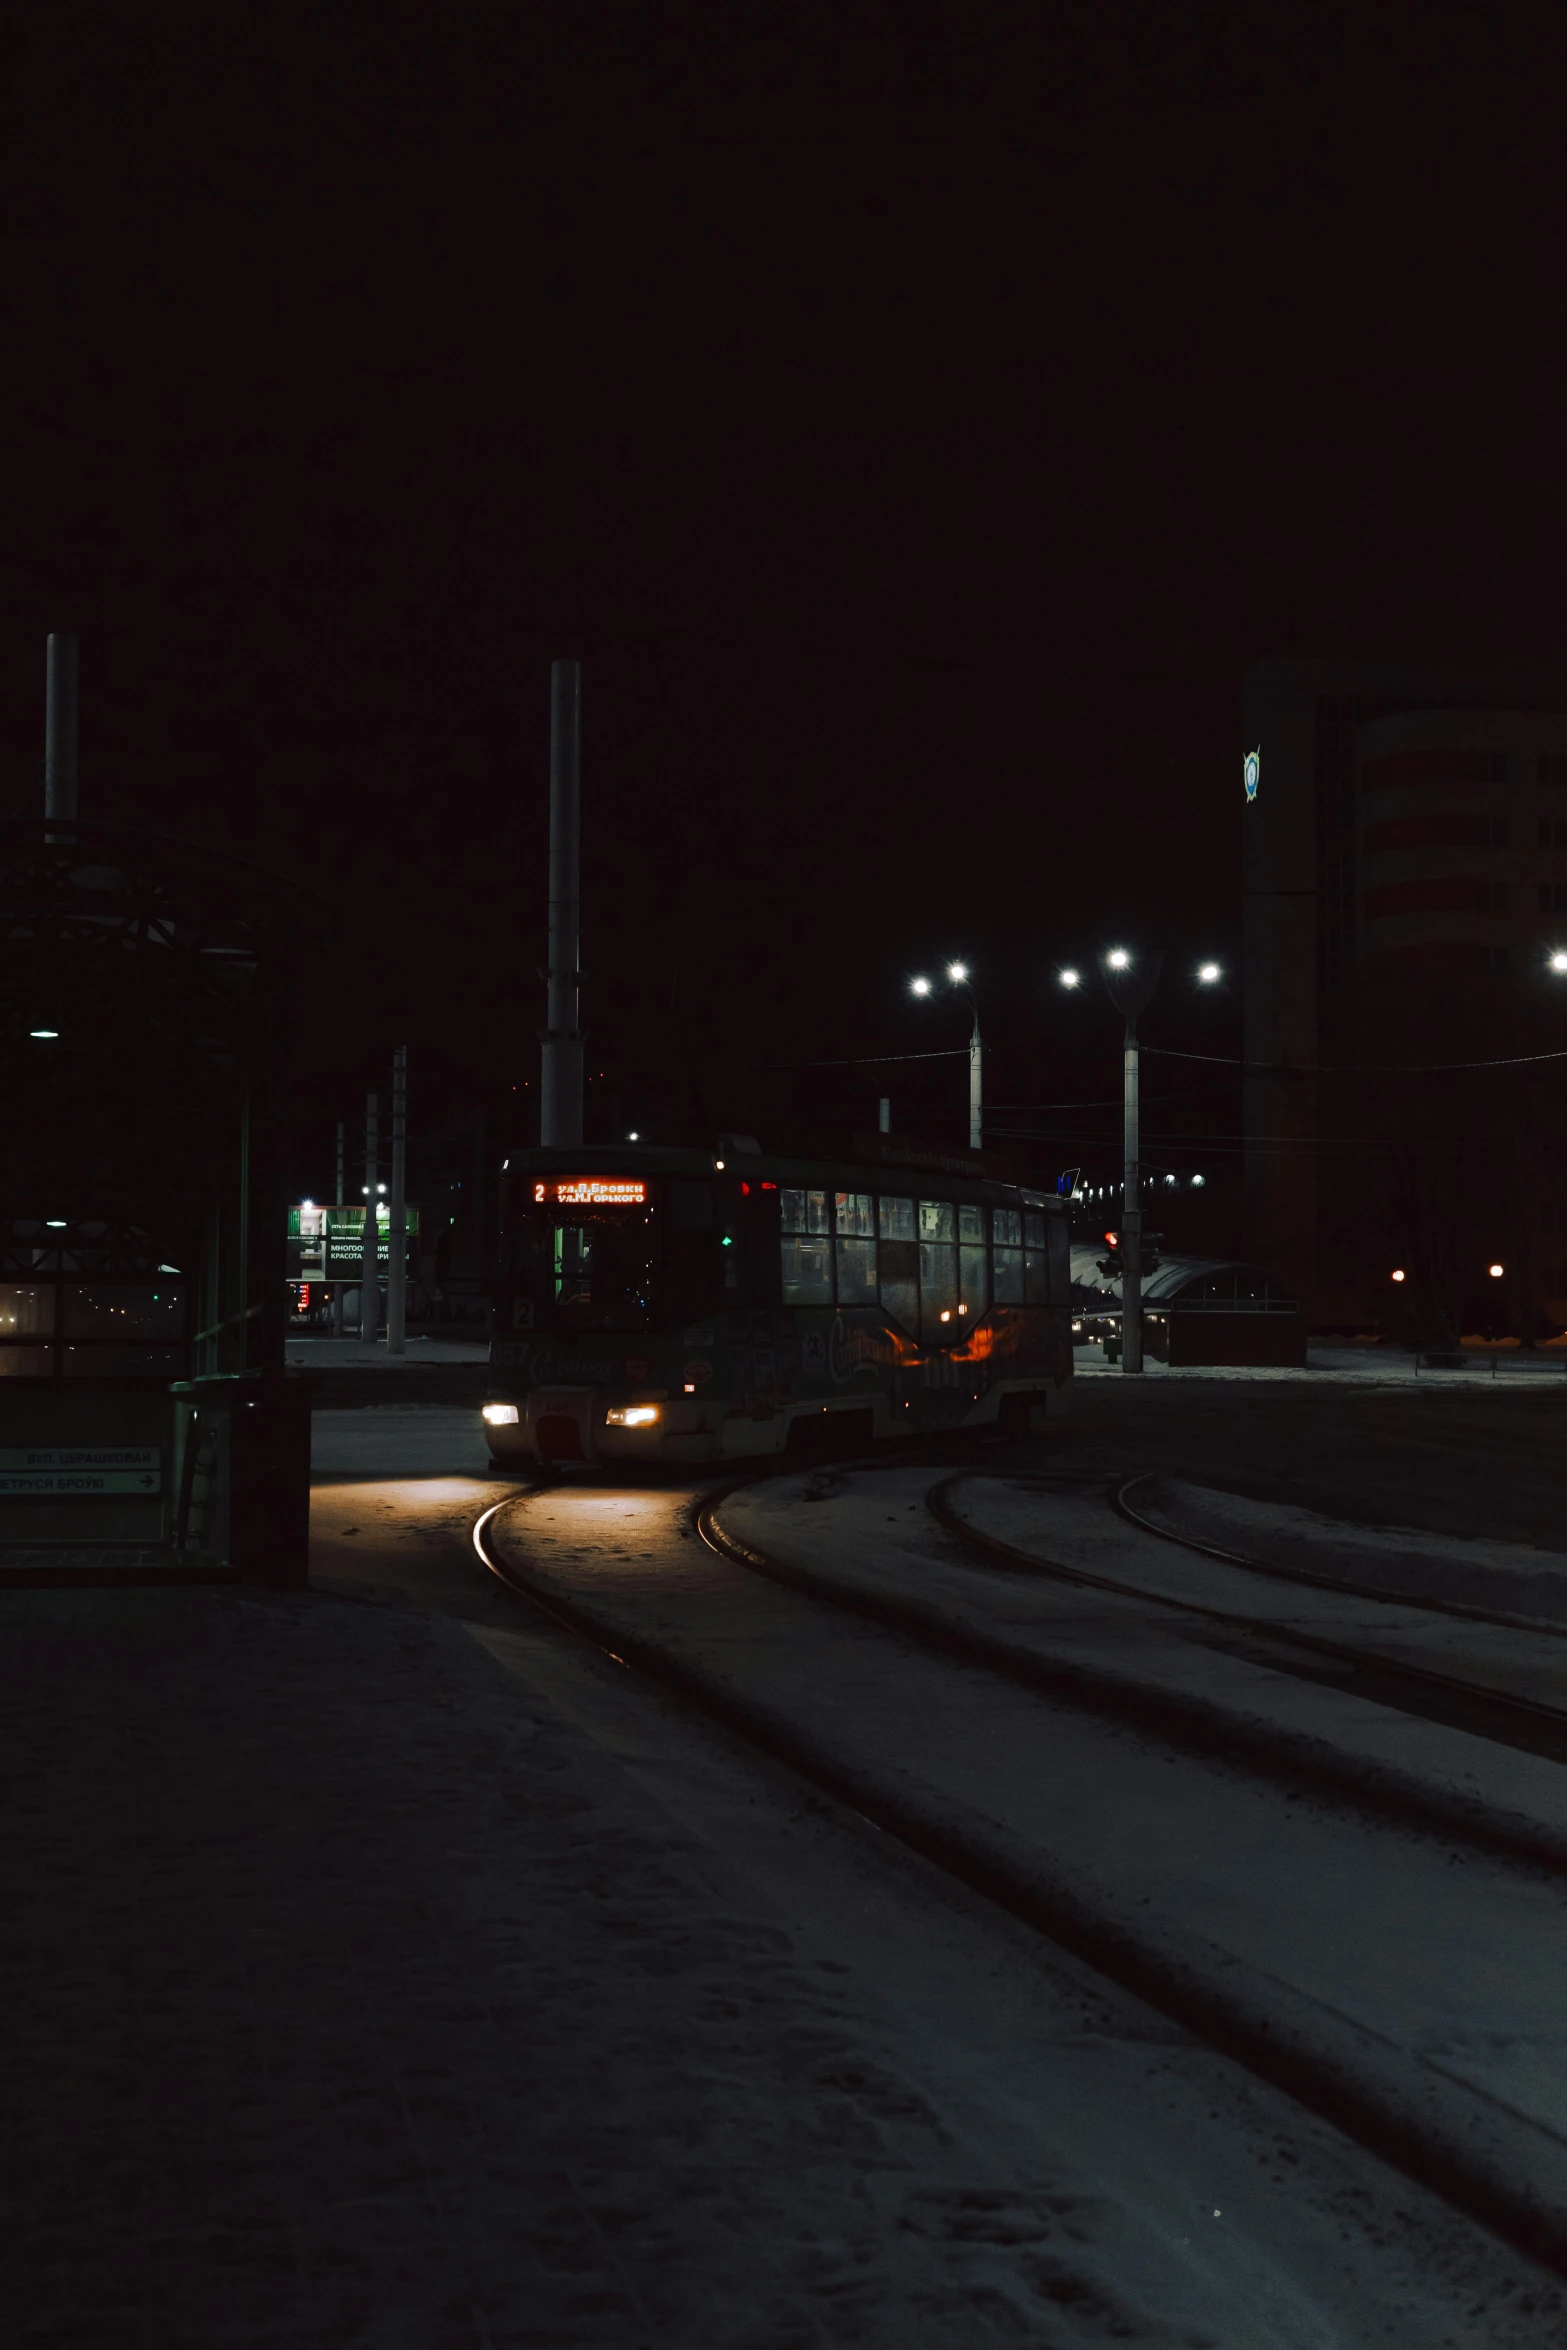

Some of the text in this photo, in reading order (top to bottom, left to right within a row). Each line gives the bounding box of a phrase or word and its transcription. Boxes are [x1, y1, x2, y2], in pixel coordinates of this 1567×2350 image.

[535, 1184, 545, 1202] 2
[27, 1453, 151, 1465] ВУЛ. ЦЕРАШКОВАЙ
[57, 1476, 104, 1489] БРОЎКІ
